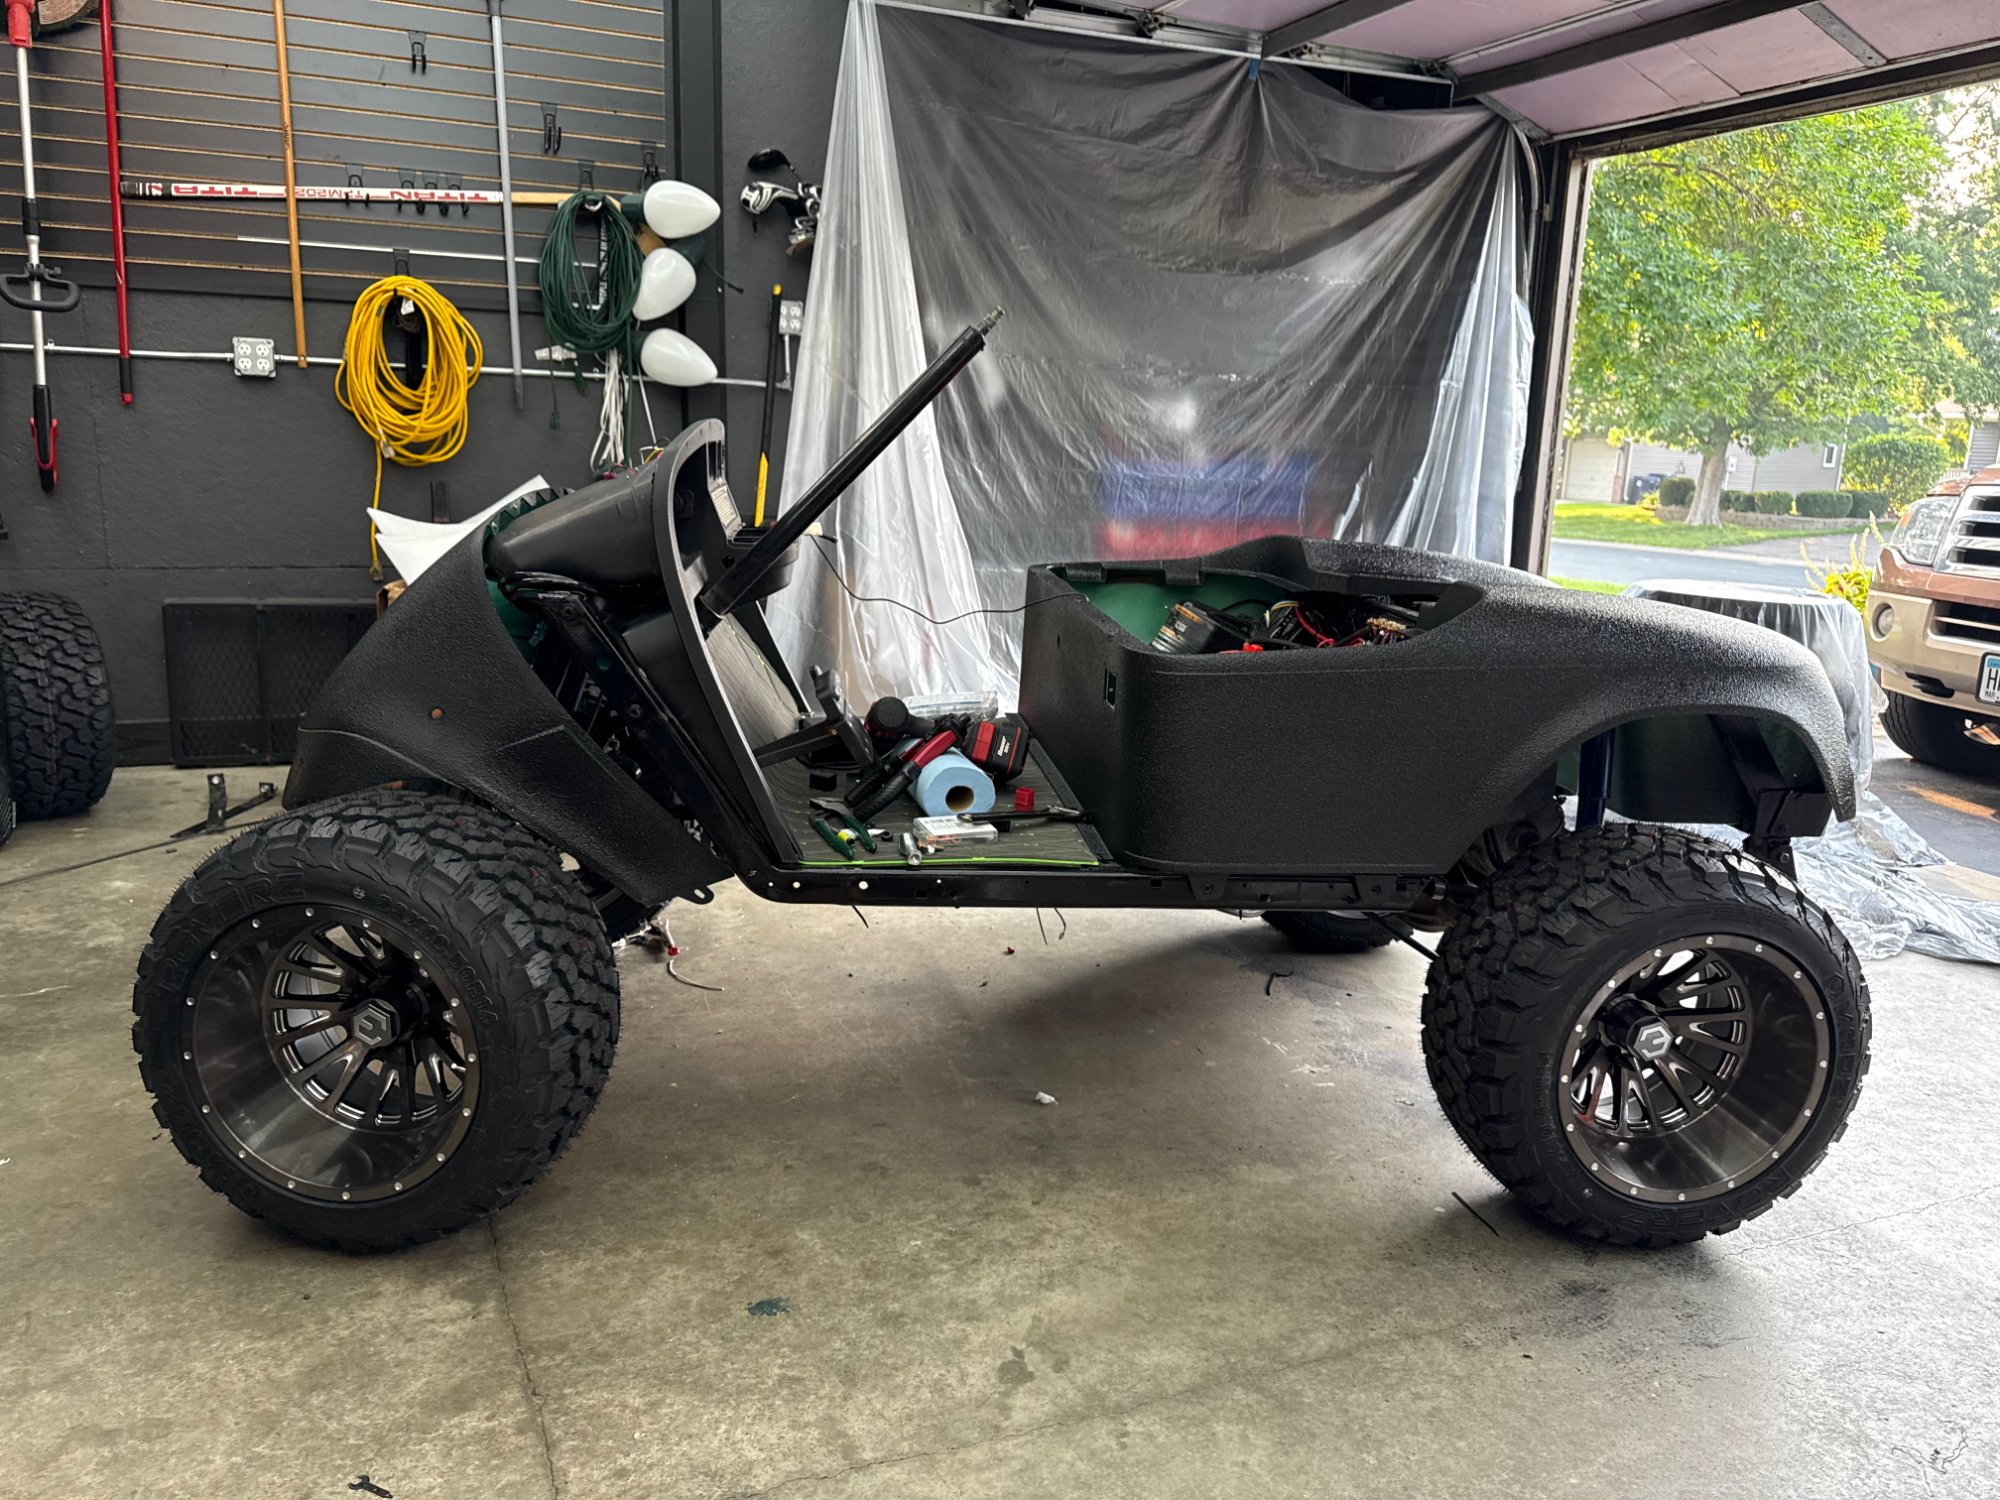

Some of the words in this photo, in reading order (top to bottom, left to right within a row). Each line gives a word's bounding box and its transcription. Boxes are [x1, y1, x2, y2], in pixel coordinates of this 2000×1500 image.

[389, 190, 488, 202] TITAN
[1986, 668, 2000, 691] H
[156, 874, 307, 994] ROVERZ
[1617, 1164, 1793, 1234] ROVERZ
